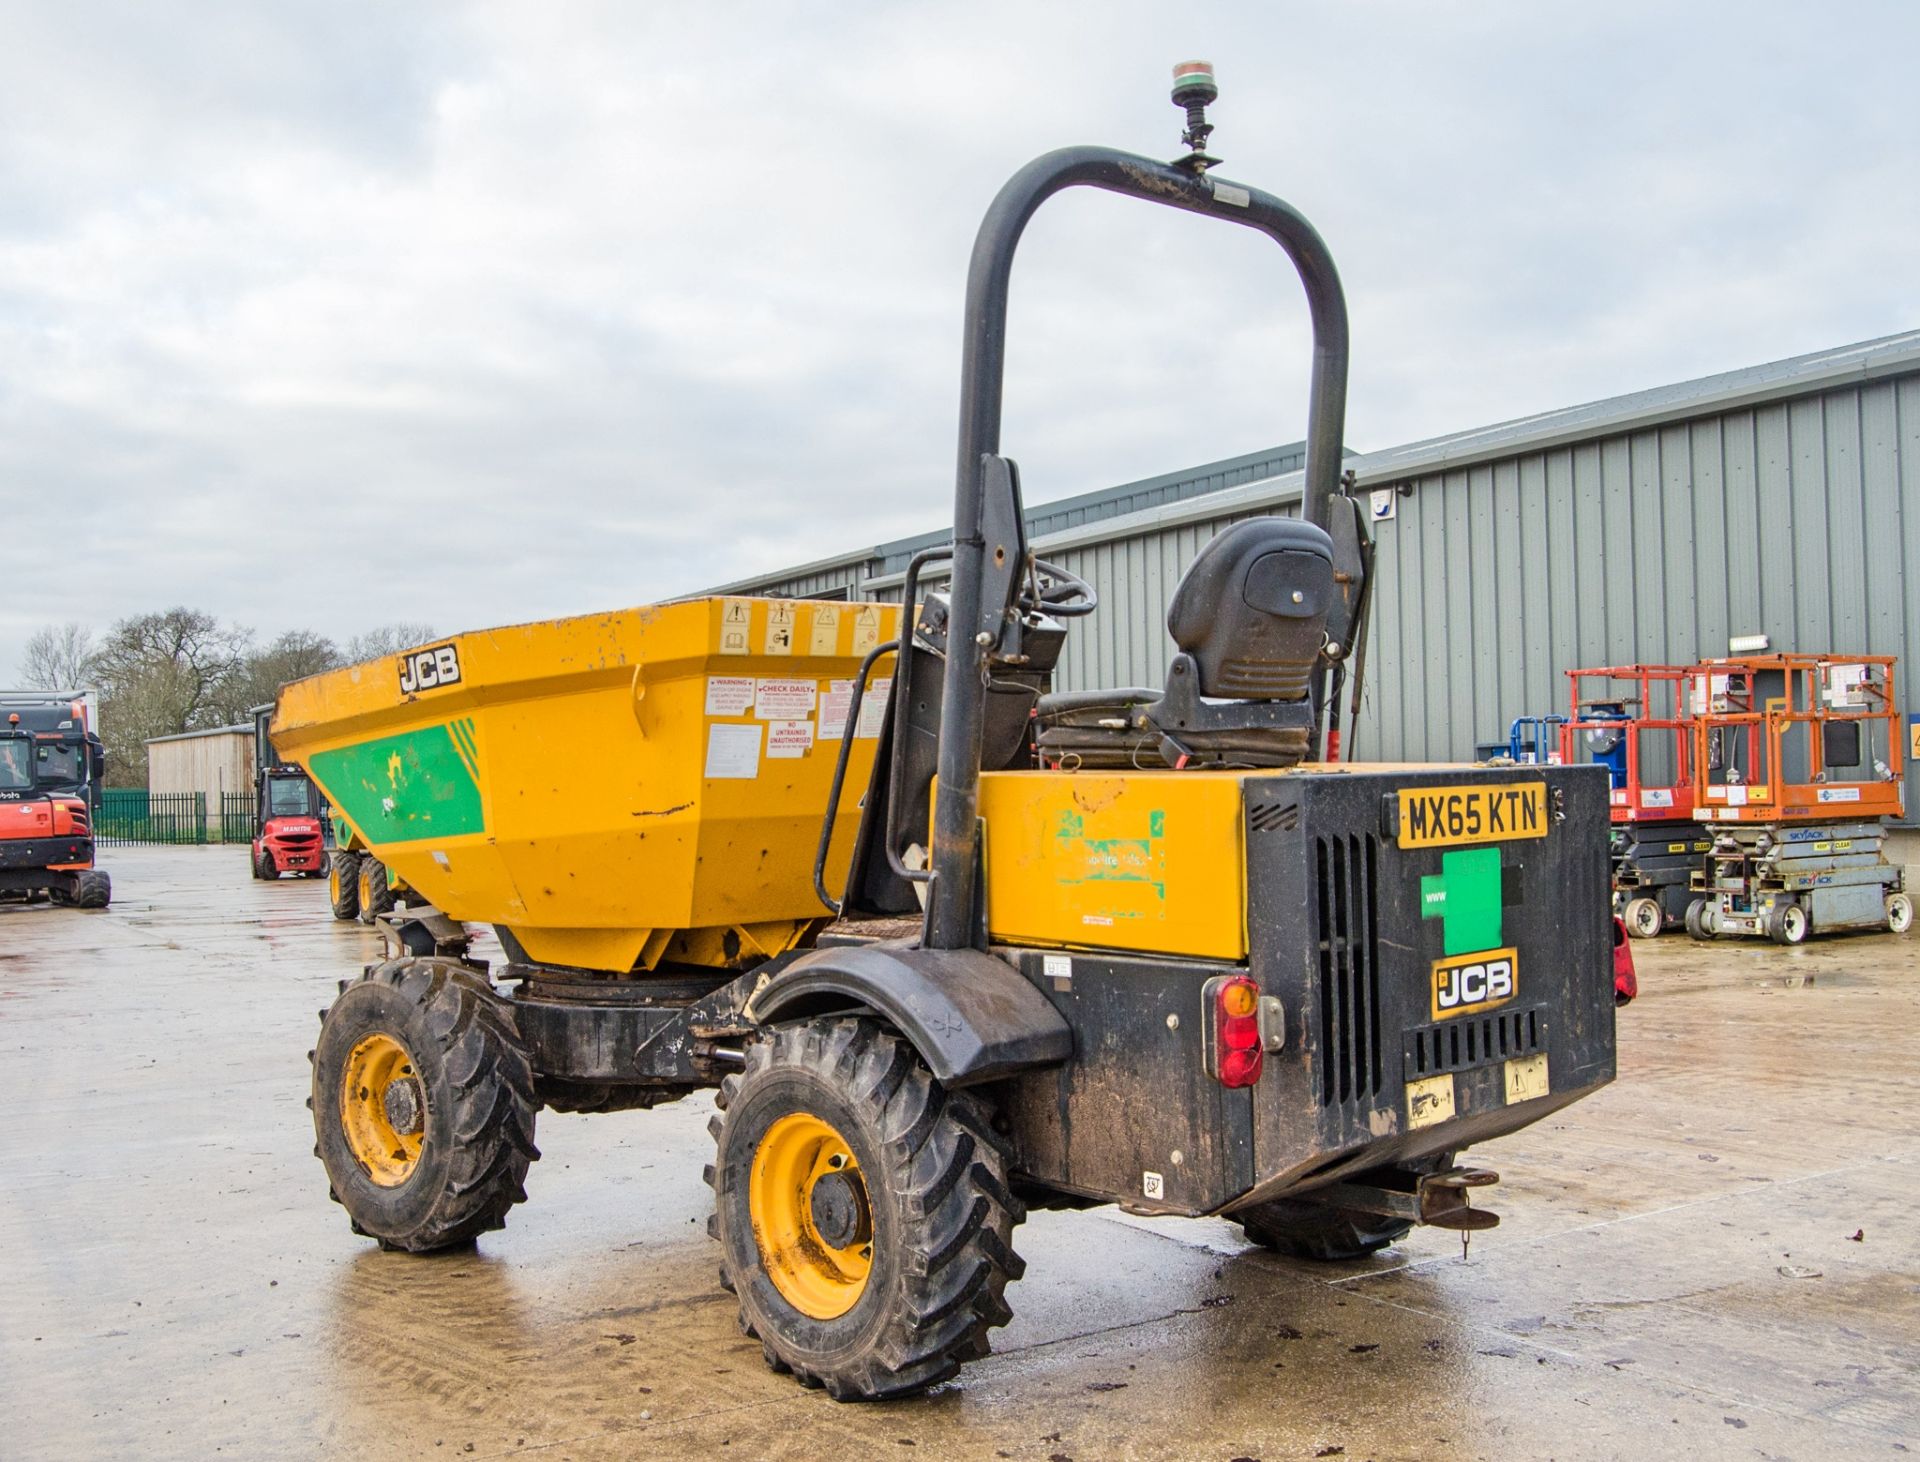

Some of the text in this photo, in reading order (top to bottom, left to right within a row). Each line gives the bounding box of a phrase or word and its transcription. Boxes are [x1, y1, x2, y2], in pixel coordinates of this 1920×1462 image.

[400, 647, 460, 691] JCB
[763, 685, 811, 693] CHECK DAILY
[770, 736, 811, 744] UNAUTHORISED
[1409, 790, 1537, 840] MX65 KTN
[282, 825, 312, 833] MANITOU
[1790, 829, 1824, 840] SKYJACK
[1835, 841, 1850, 849] CLEAR
[1439, 961, 1512, 1007] JCB
